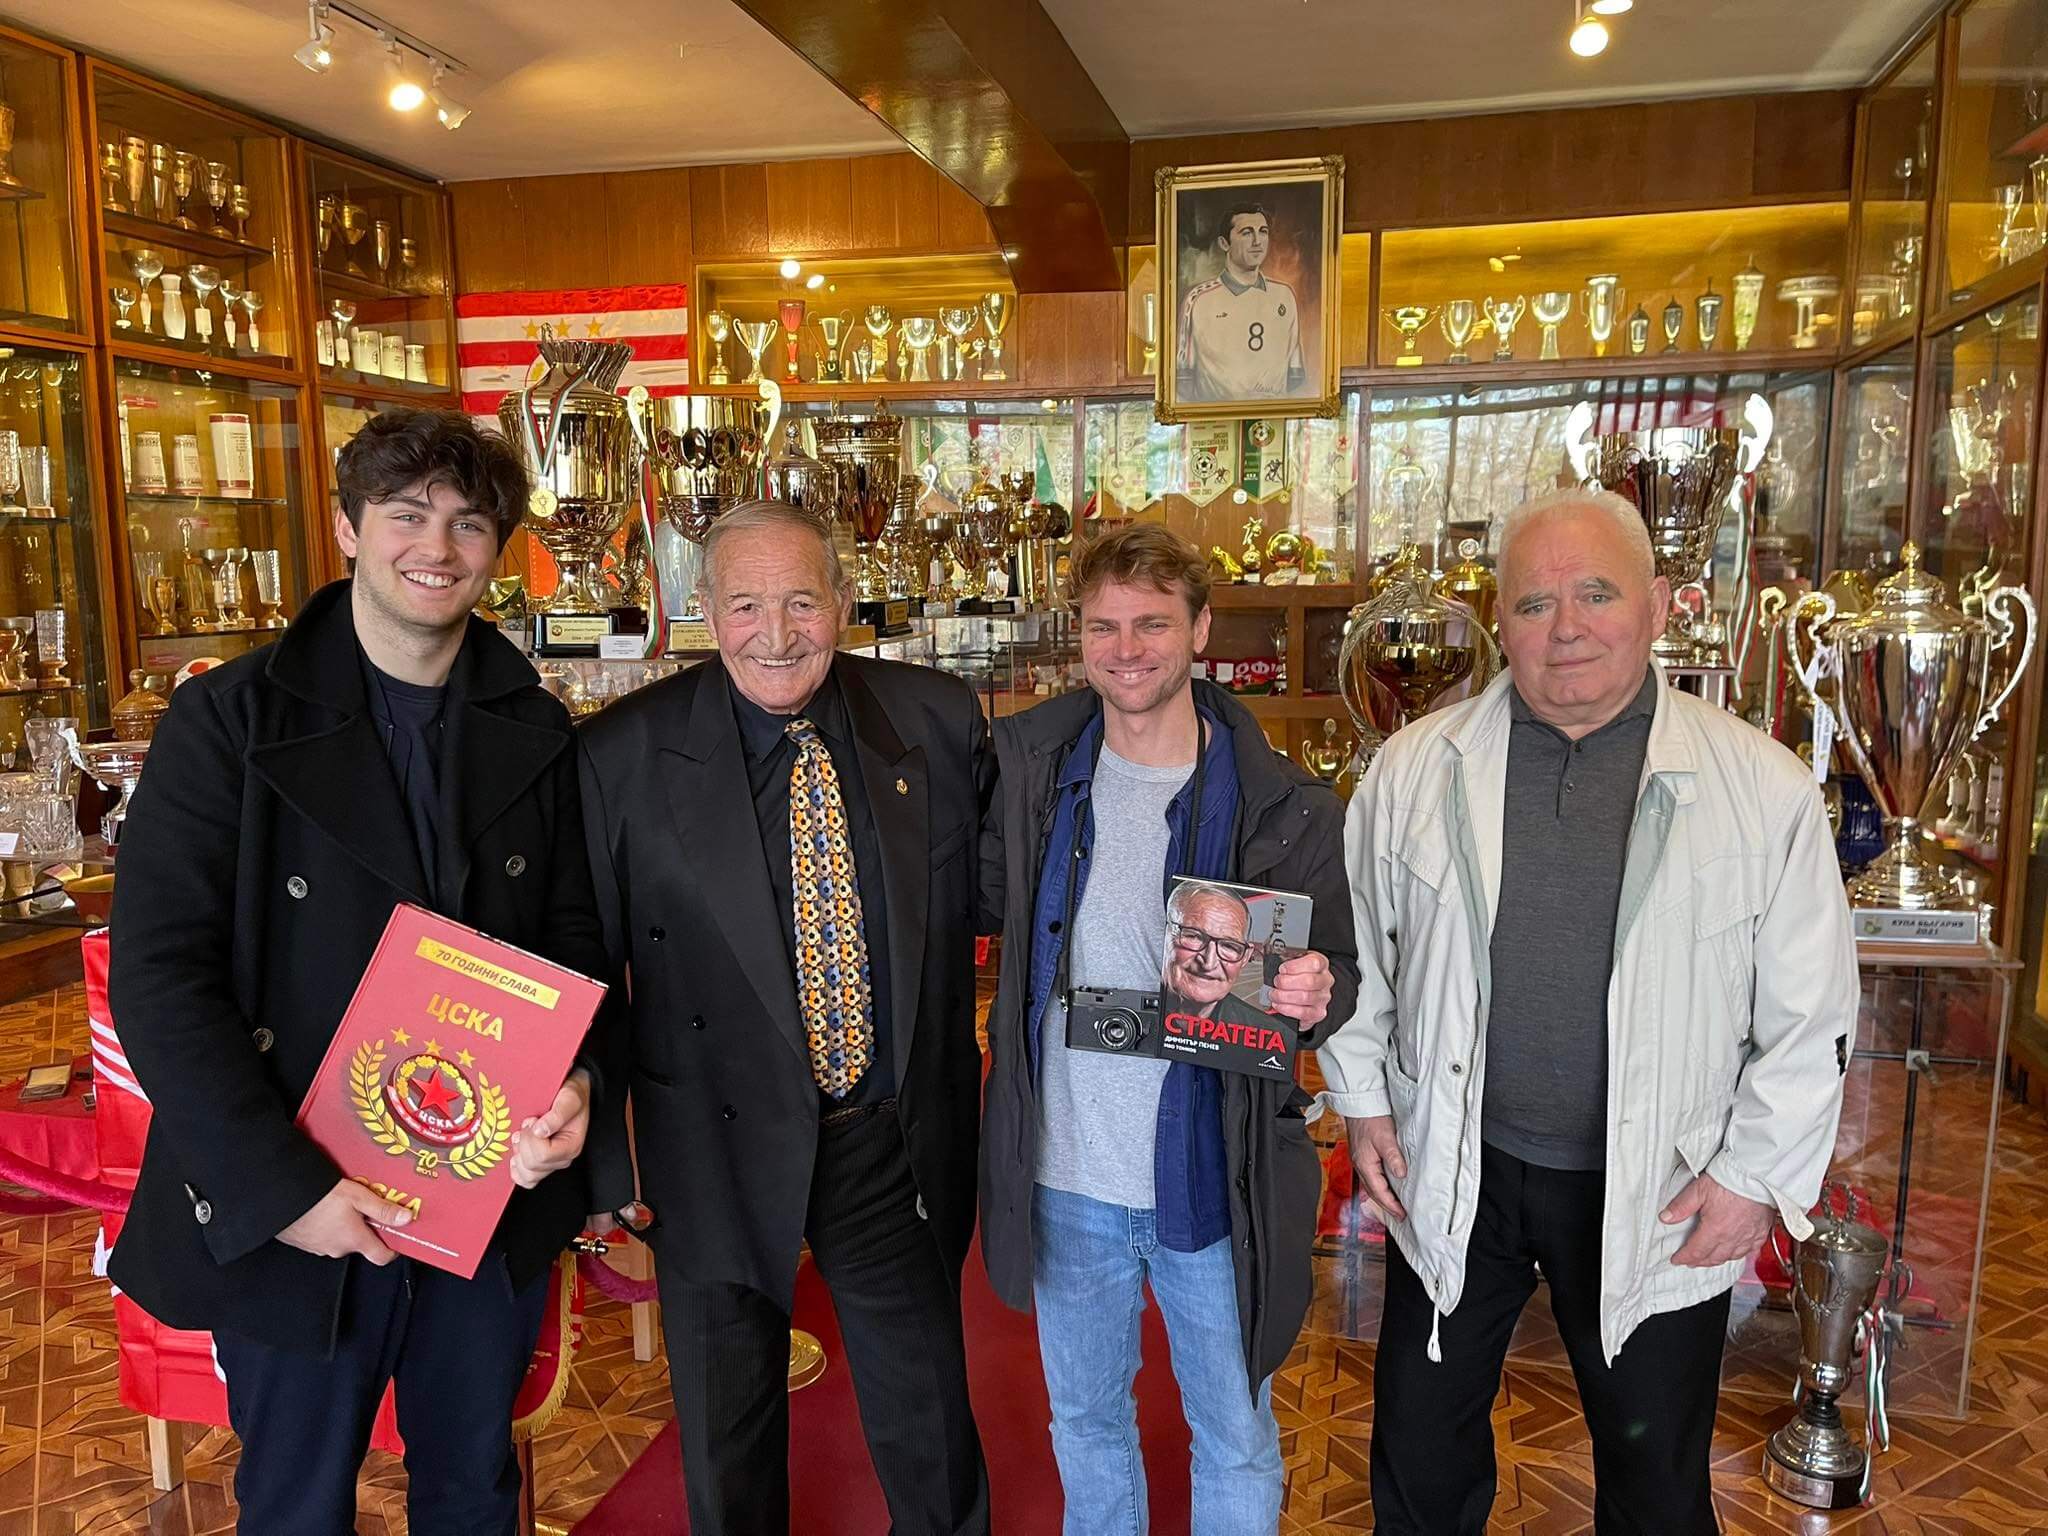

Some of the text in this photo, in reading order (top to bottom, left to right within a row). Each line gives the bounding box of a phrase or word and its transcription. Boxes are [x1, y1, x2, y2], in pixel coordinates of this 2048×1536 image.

[1248, 322, 1264, 351] 8
[1892, 919, 1915, 927] КУПА
[436, 950, 538, 997] 70 ГОДИНИ СЛАВА
[426, 993, 504, 1042] ЦСКА
[1164, 1012, 1286, 1054] СТРАТЕГА
[419, 1110, 454, 1129] ЦСКА
[418, 1149, 438, 1169] 70
